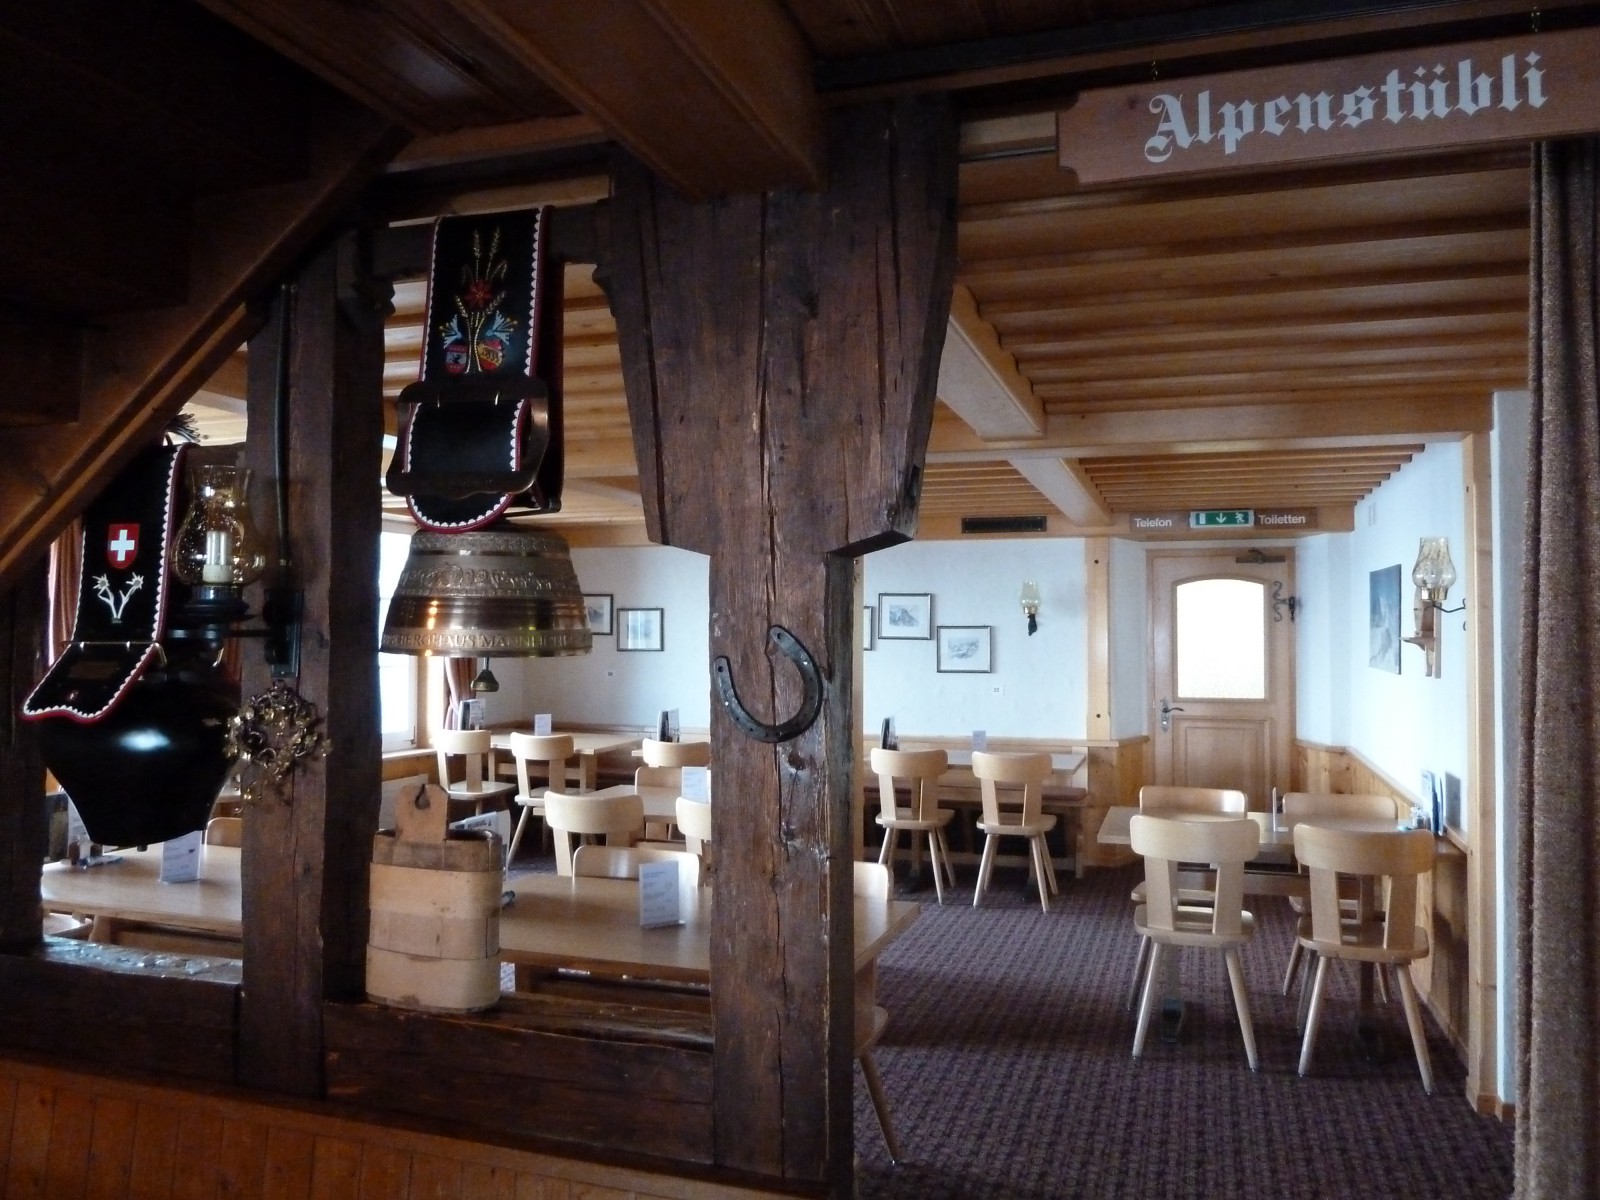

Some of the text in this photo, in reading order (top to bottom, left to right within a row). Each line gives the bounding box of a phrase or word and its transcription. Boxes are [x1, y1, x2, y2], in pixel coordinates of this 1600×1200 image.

[1144, 50, 1549, 163] Alpenstübli
[1134, 517, 1172, 528] Telefon
[1258, 514, 1306, 525] Toiletten
